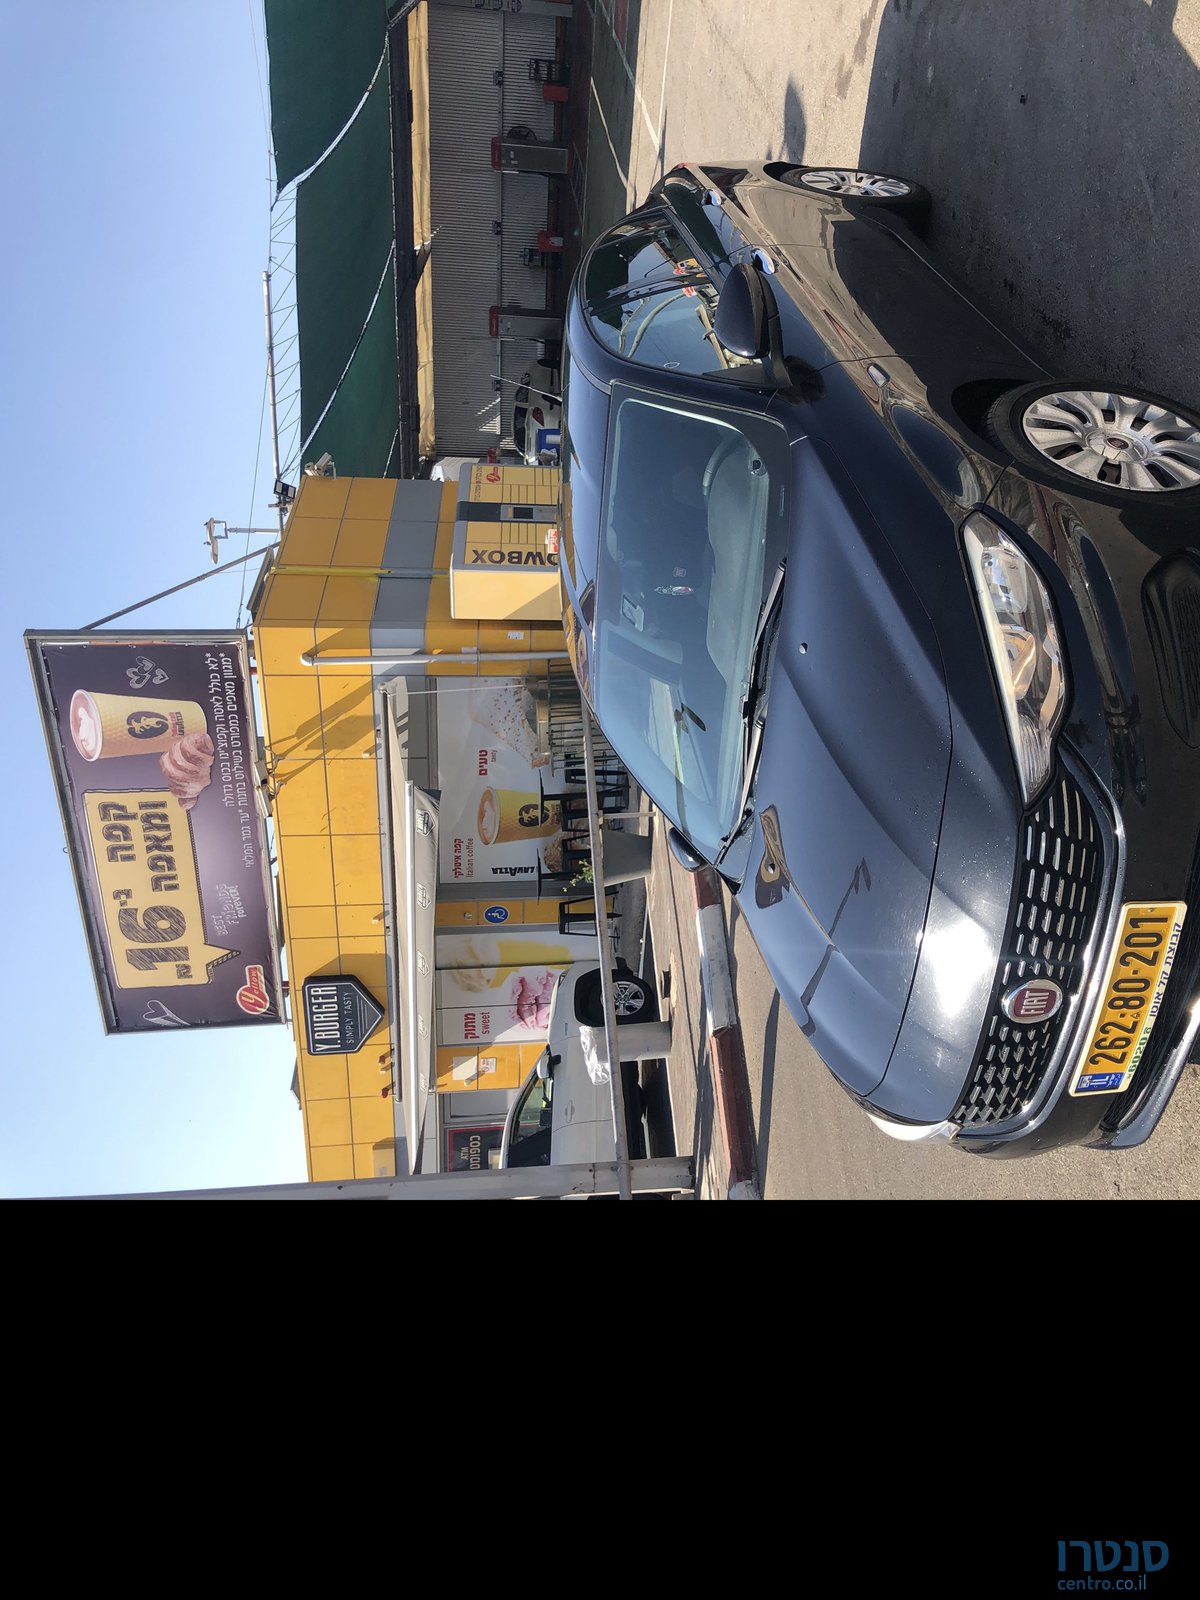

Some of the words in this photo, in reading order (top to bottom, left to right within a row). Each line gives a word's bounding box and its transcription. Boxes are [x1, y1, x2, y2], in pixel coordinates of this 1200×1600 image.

[209, 673, 222, 693] כולל
[225, 682, 237, 711] מאפים
[210, 696, 225, 721] לאטה
[228, 714, 240, 747] כמפורט
[232, 750, 244, 779] בשילוט
[479, 750, 488, 776] טעים
[490, 750, 498, 763] tasty
[221, 762, 231, 781] בכוס
[222, 784, 235, 807] גדולה
[236, 782, 248, 806] בחנות
[98, 801, 138, 862] קפה
[241, 826, 251, 840] גמר
[138, 801, 179, 892] ומאפה
[453, 838, 463, 854] קפה
[466, 838, 474, 857] coffee
[452, 855, 464, 878] איטלקי
[466, 859, 474, 878] Italian
[211, 915, 228, 935] BEST
[1165, 922, 1182, 967] קבוצת
[1159, 970, 1169, 988] קל
[343, 992, 352, 1014] TASTY
[1021, 991, 1049, 1014] FIAT
[311, 987, 341, 1051] Y.BURGER
[345, 1018, 354, 1043] SIMPLY
[463, 1013, 479, 1039] מתוק
[479, 1012, 490, 1034] sweet
[461, 1147, 469, 1160] ATM
[470, 1136, 480, 1169] כספומט
